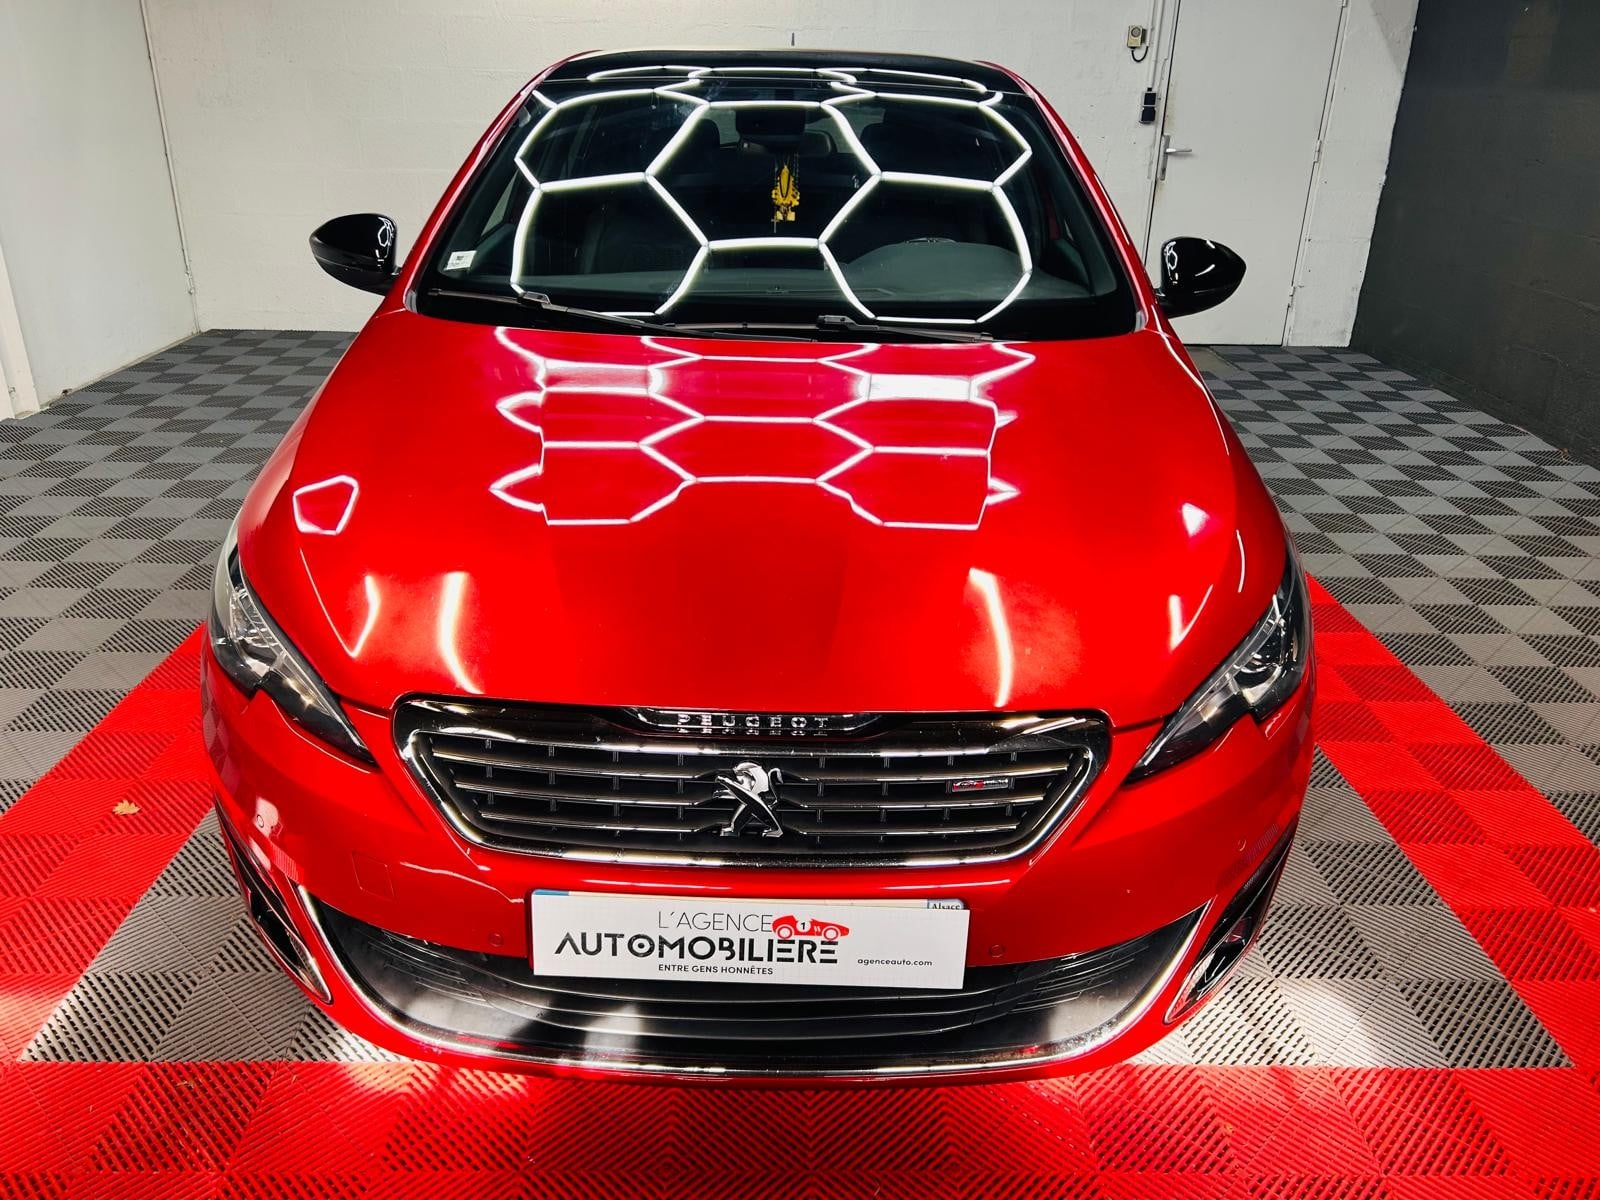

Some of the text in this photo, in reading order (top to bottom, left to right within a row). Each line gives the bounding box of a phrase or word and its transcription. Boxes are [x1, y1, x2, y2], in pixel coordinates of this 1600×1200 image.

[677, 713, 829, 728] PEUGEOT
[932, 902, 961, 910] Alsace
[800, 921, 806, 931] 1
[857, 958, 933, 967] agenceauto.com
[658, 963, 774, 976] ENTRE GENS HONNÊTES
